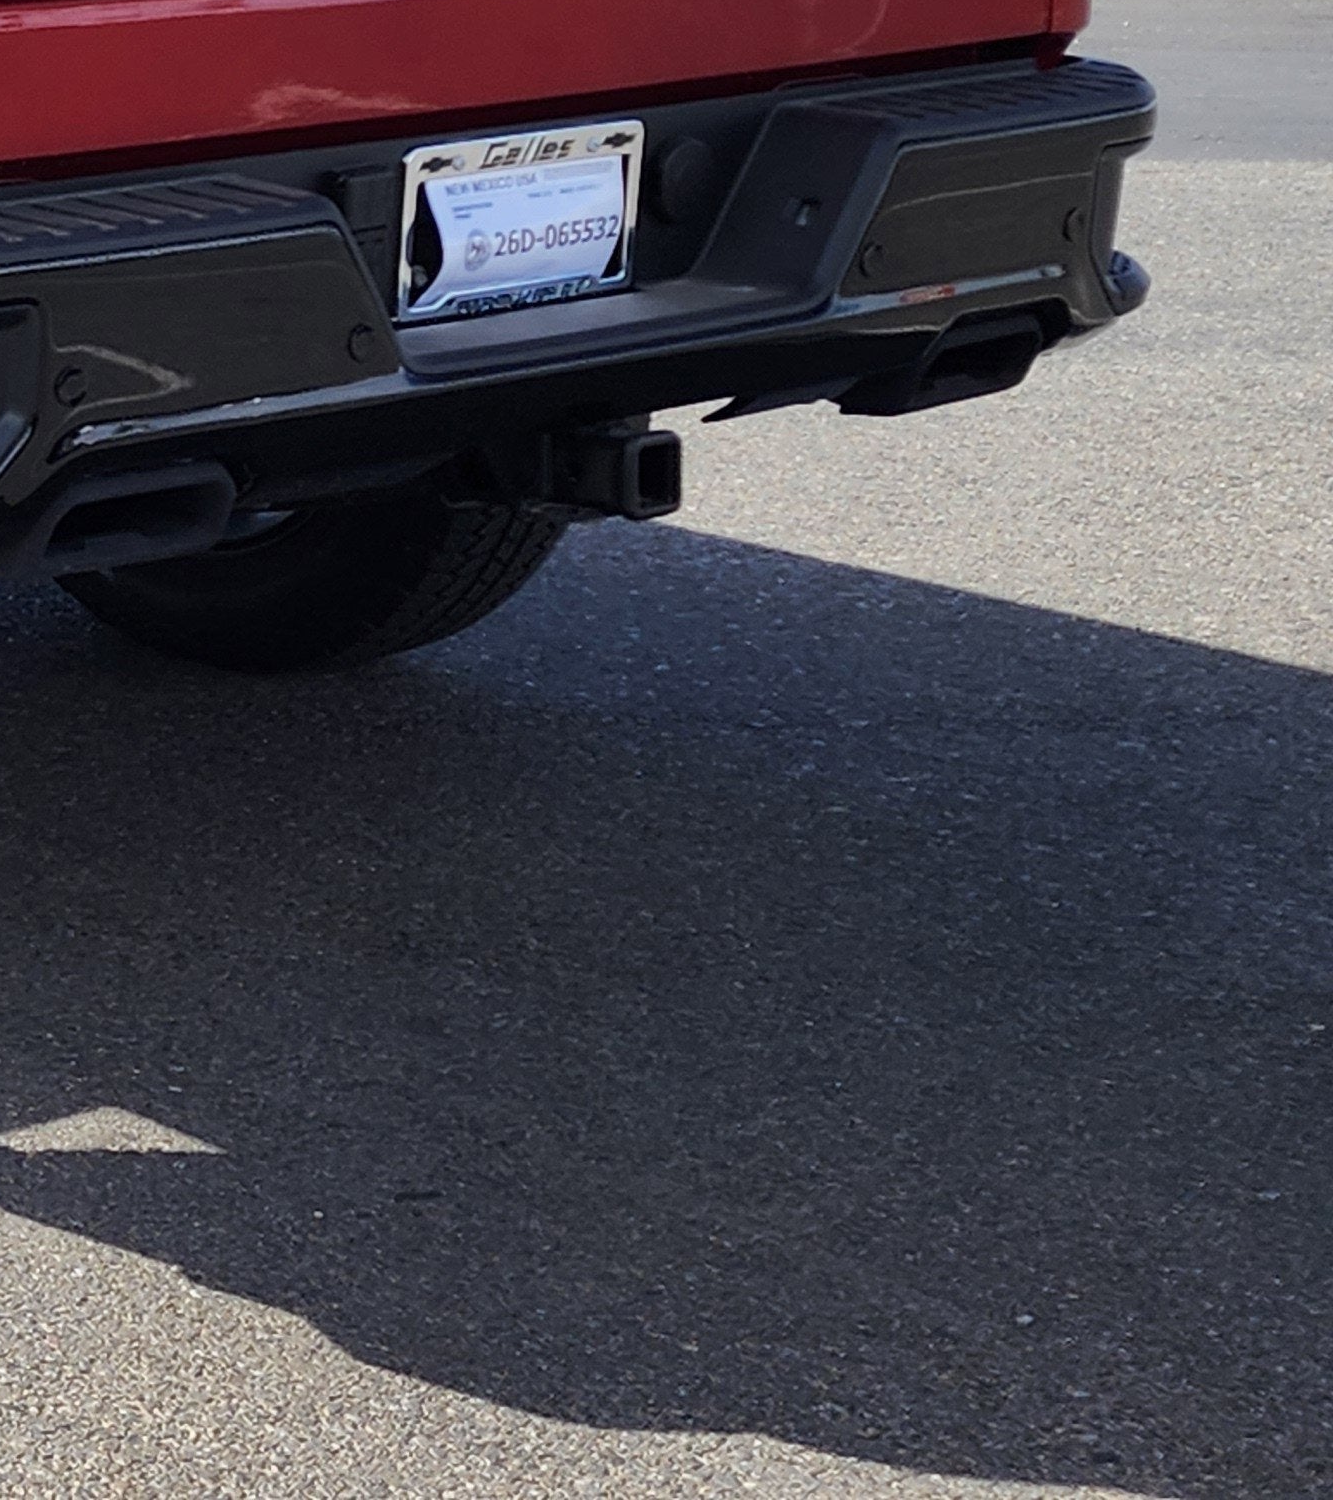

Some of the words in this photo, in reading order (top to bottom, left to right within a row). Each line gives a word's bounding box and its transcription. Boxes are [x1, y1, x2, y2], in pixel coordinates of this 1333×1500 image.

[479, 137, 576, 170] Galles
[472, 176, 514, 193] MEXICO
[493, 214, 620, 258] 26D-065532
